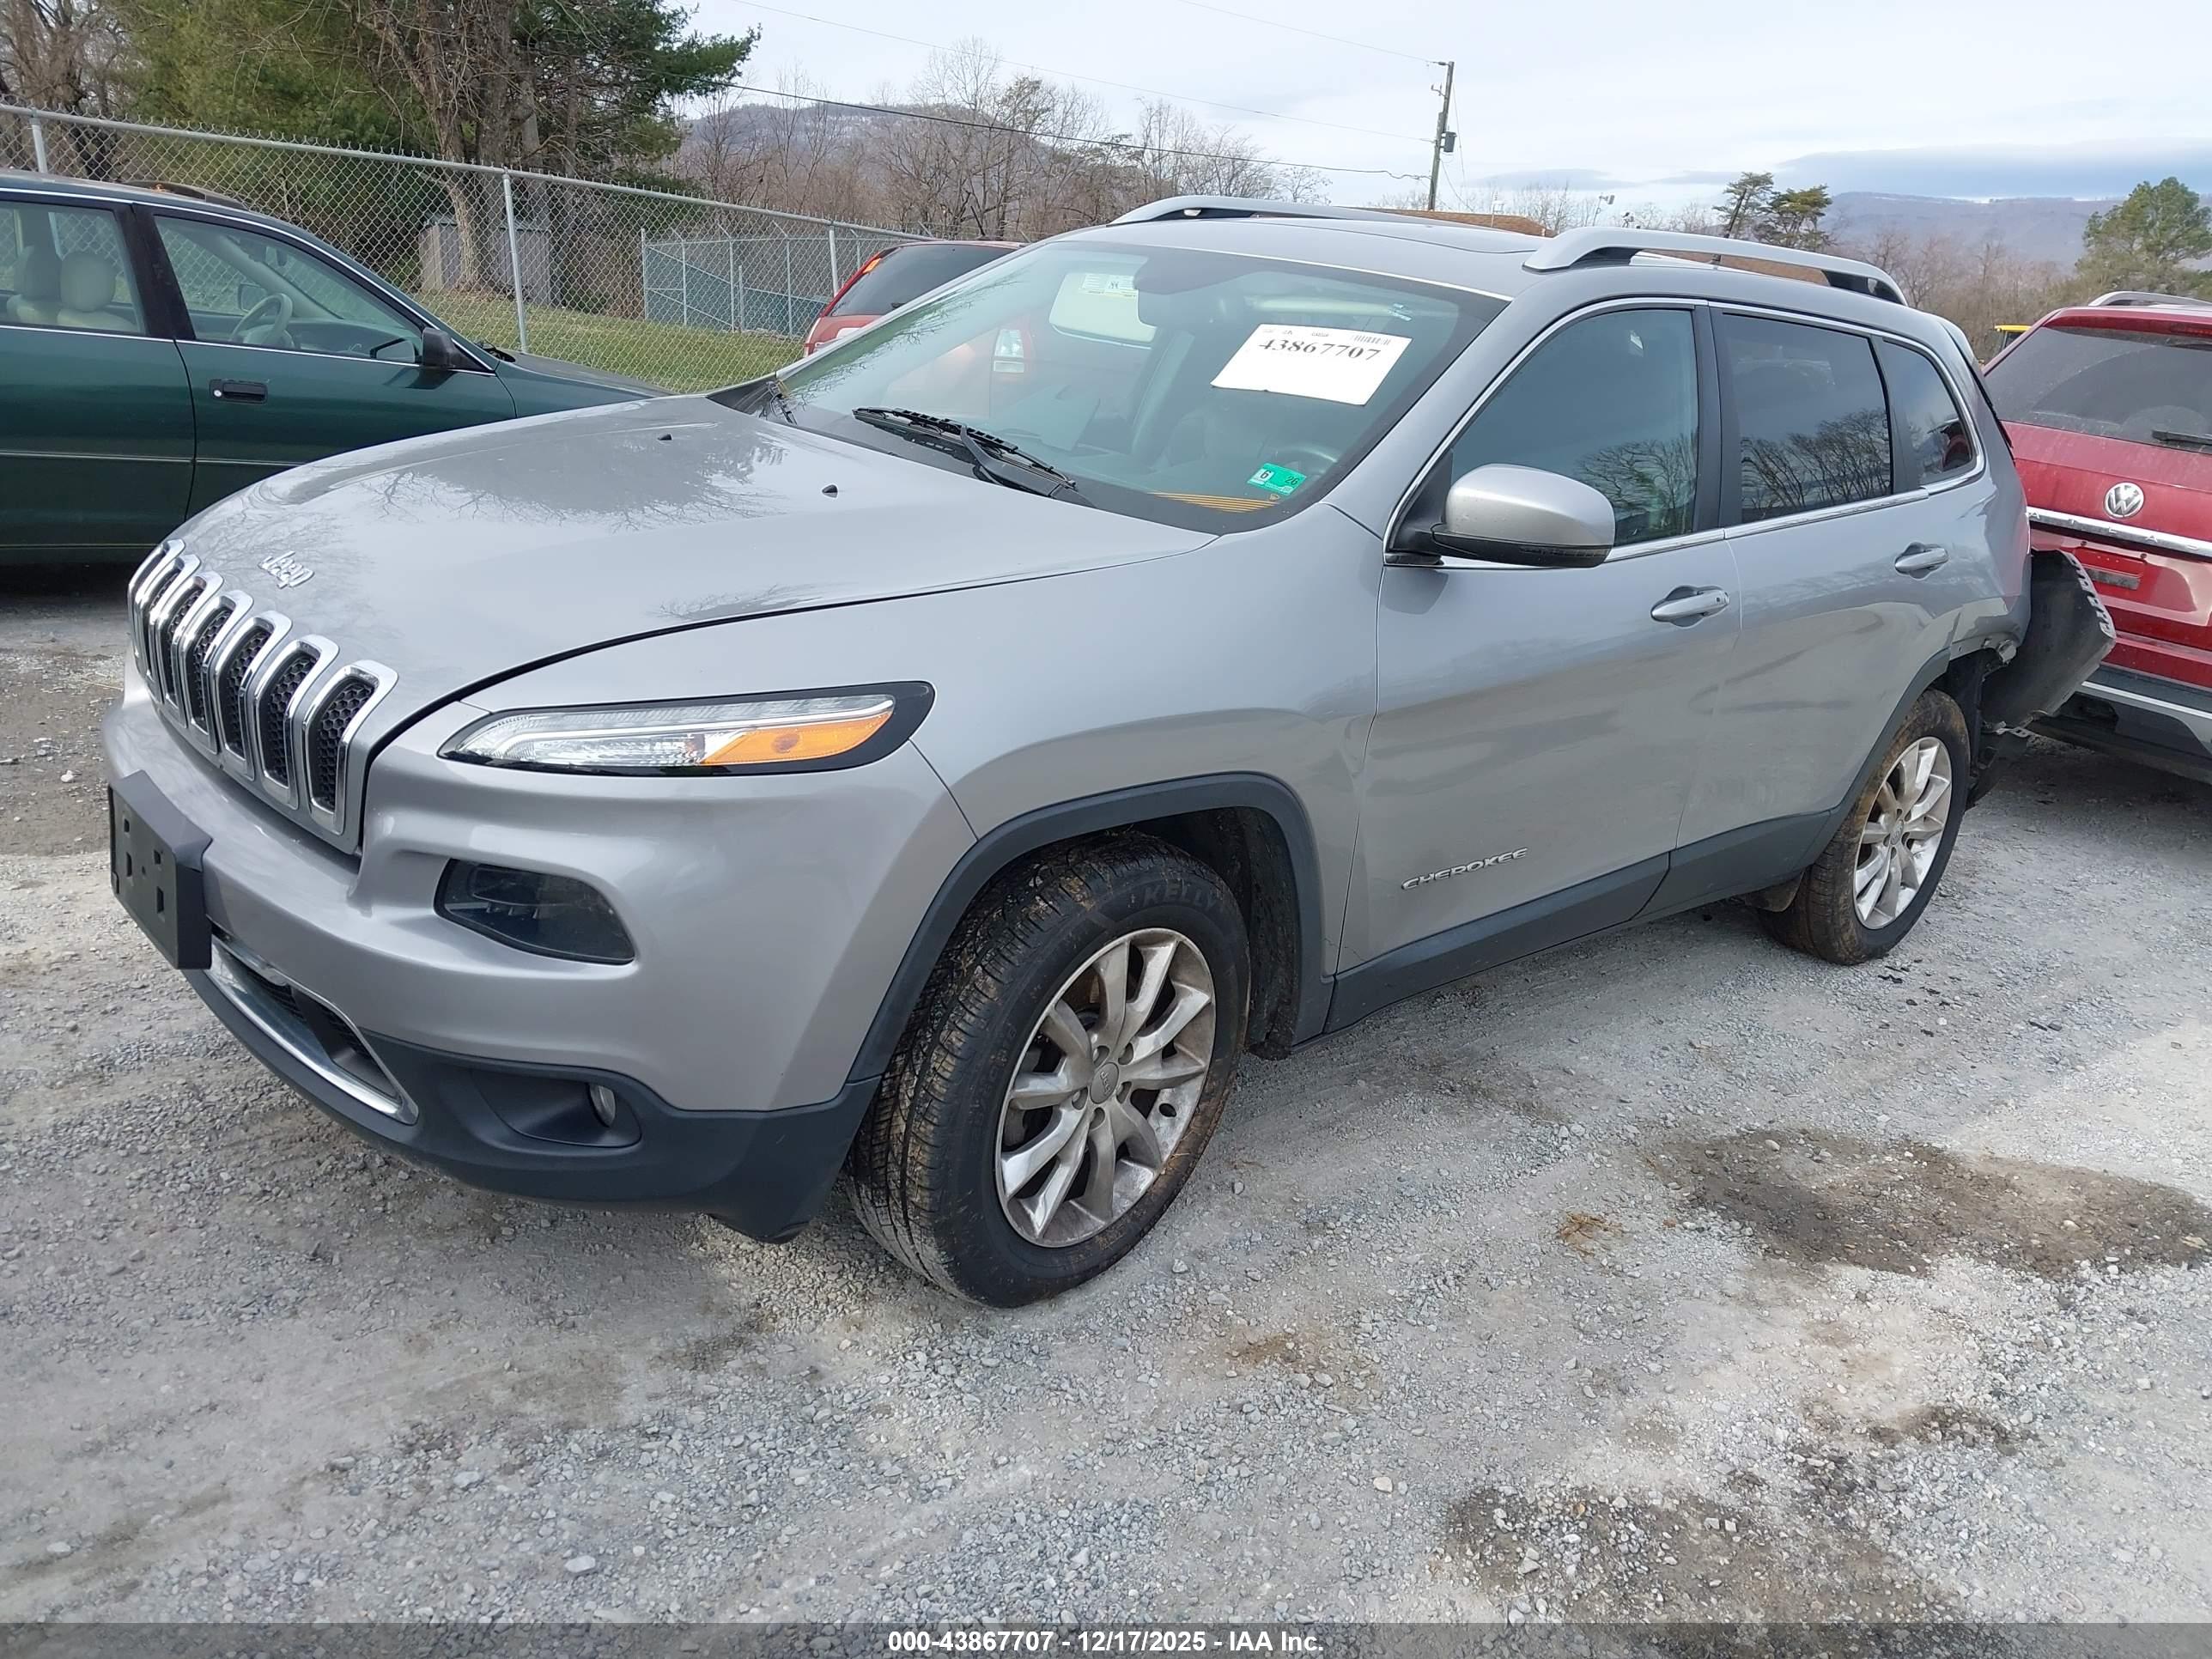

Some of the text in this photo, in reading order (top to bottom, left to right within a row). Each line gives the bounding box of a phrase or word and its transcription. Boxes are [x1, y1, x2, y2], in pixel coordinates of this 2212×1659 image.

[1258, 339, 1382, 361] 43867707
[1260, 470, 1300, 486] 6 26
[257, 550, 315, 590] Jeep
[1401, 847, 1528, 890] CHEROKEE
